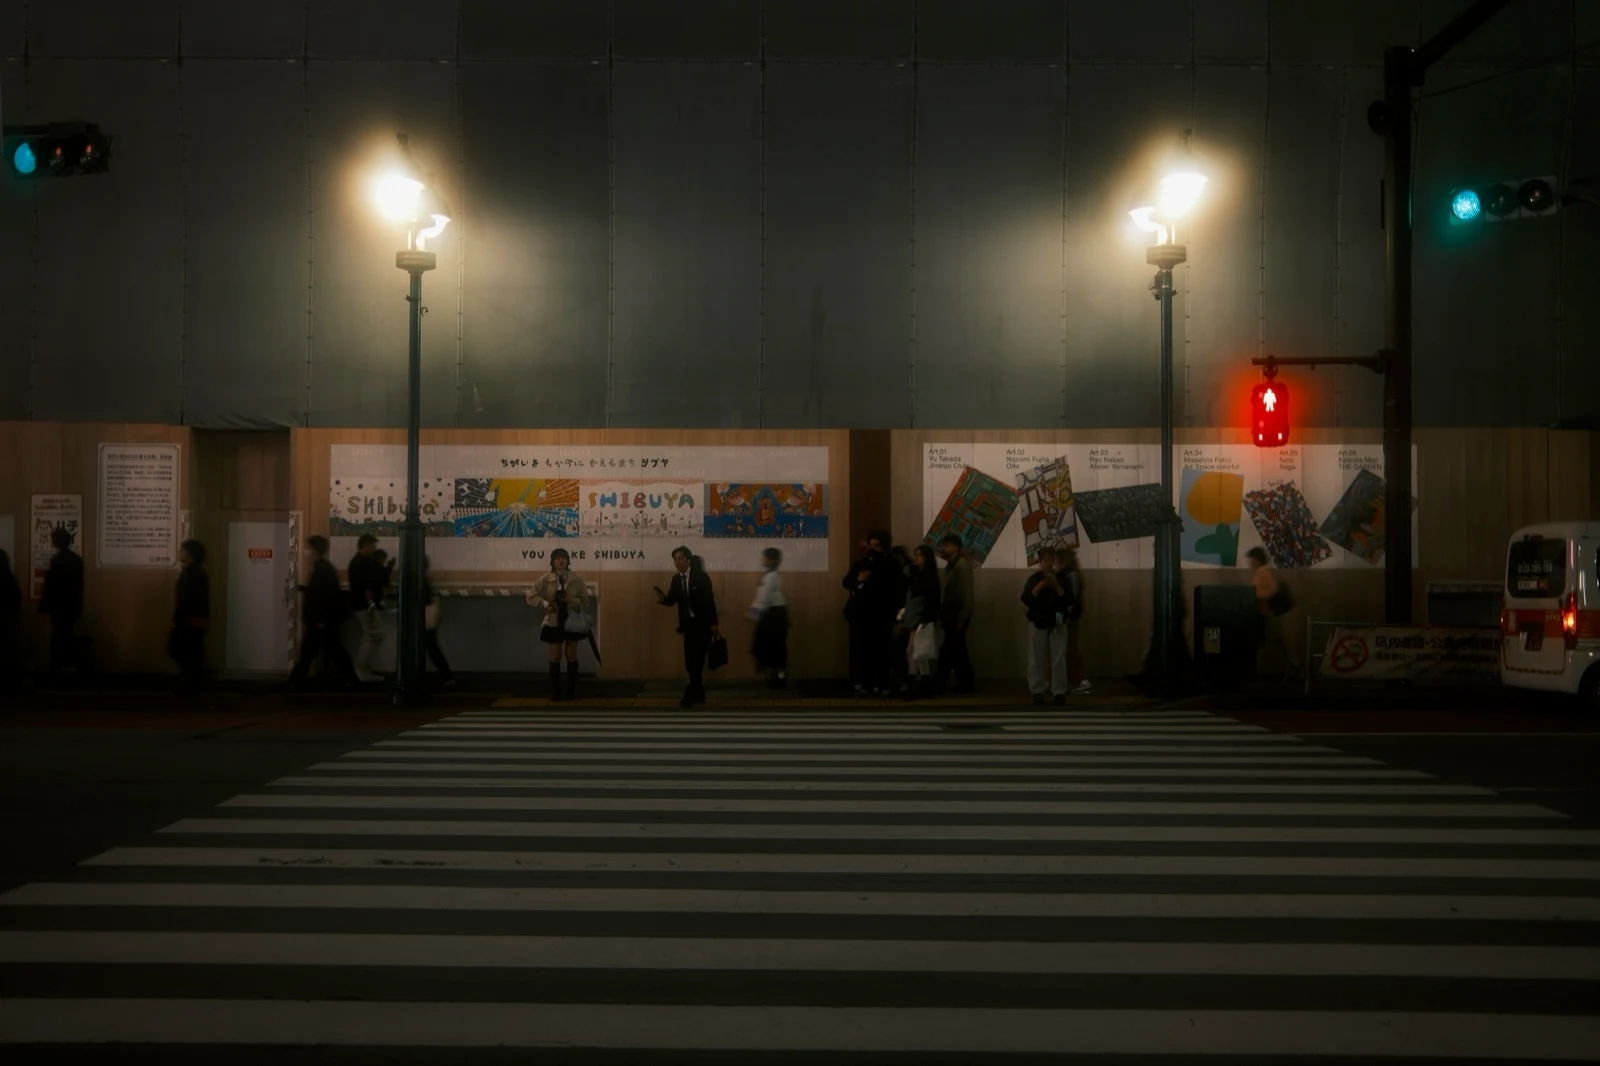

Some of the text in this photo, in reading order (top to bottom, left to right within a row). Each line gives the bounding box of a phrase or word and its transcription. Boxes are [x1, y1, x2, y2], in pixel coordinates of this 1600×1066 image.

[640, 458, 669, 468] シブヤ
[1195, 463, 1215, 471] Space
[347, 495, 436, 515] Shibua
[588, 491, 695, 510] SHIBUYA
[521, 550, 545, 559] YOU
[594, 550, 646, 559] SHIBUYA
